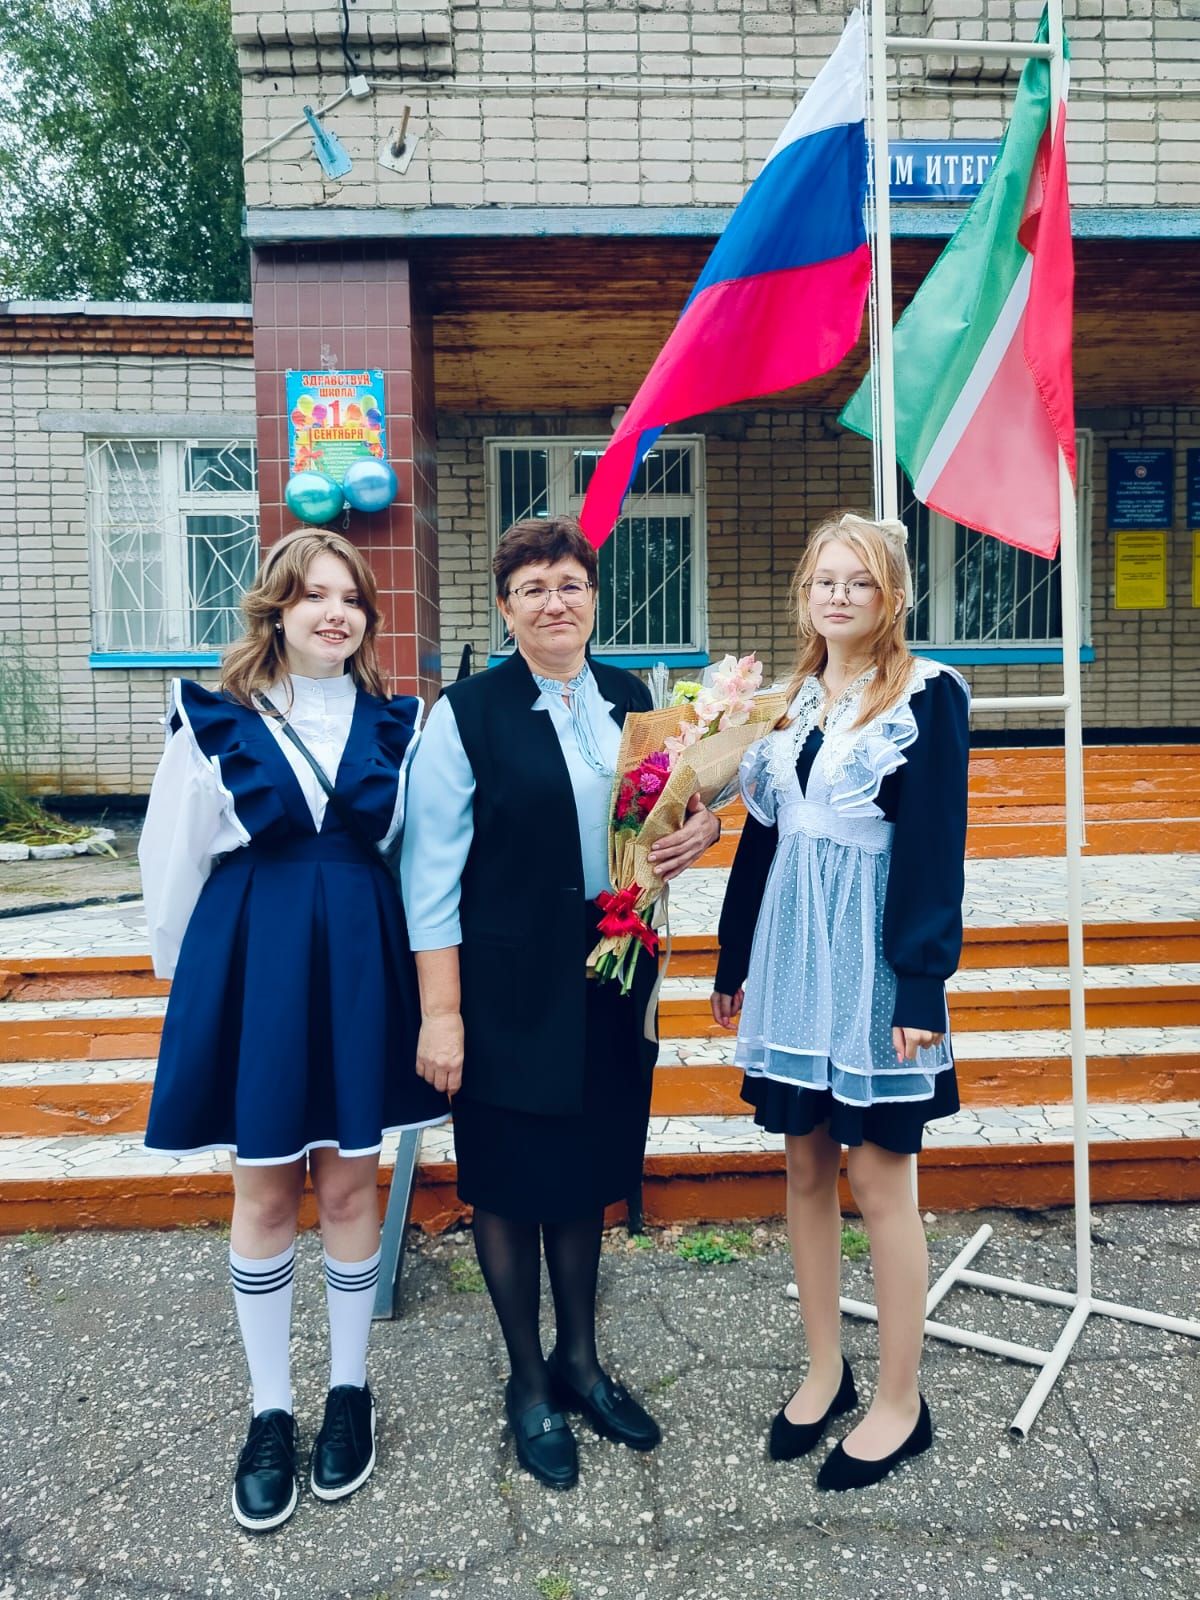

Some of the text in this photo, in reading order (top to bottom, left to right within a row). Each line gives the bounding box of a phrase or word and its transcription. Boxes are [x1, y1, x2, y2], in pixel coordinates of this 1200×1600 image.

[926, 155, 998, 185] ИТЕГ
[328, 400, 342, 428] 1
[313, 428, 364, 440] СЕНТЯБРЯ
